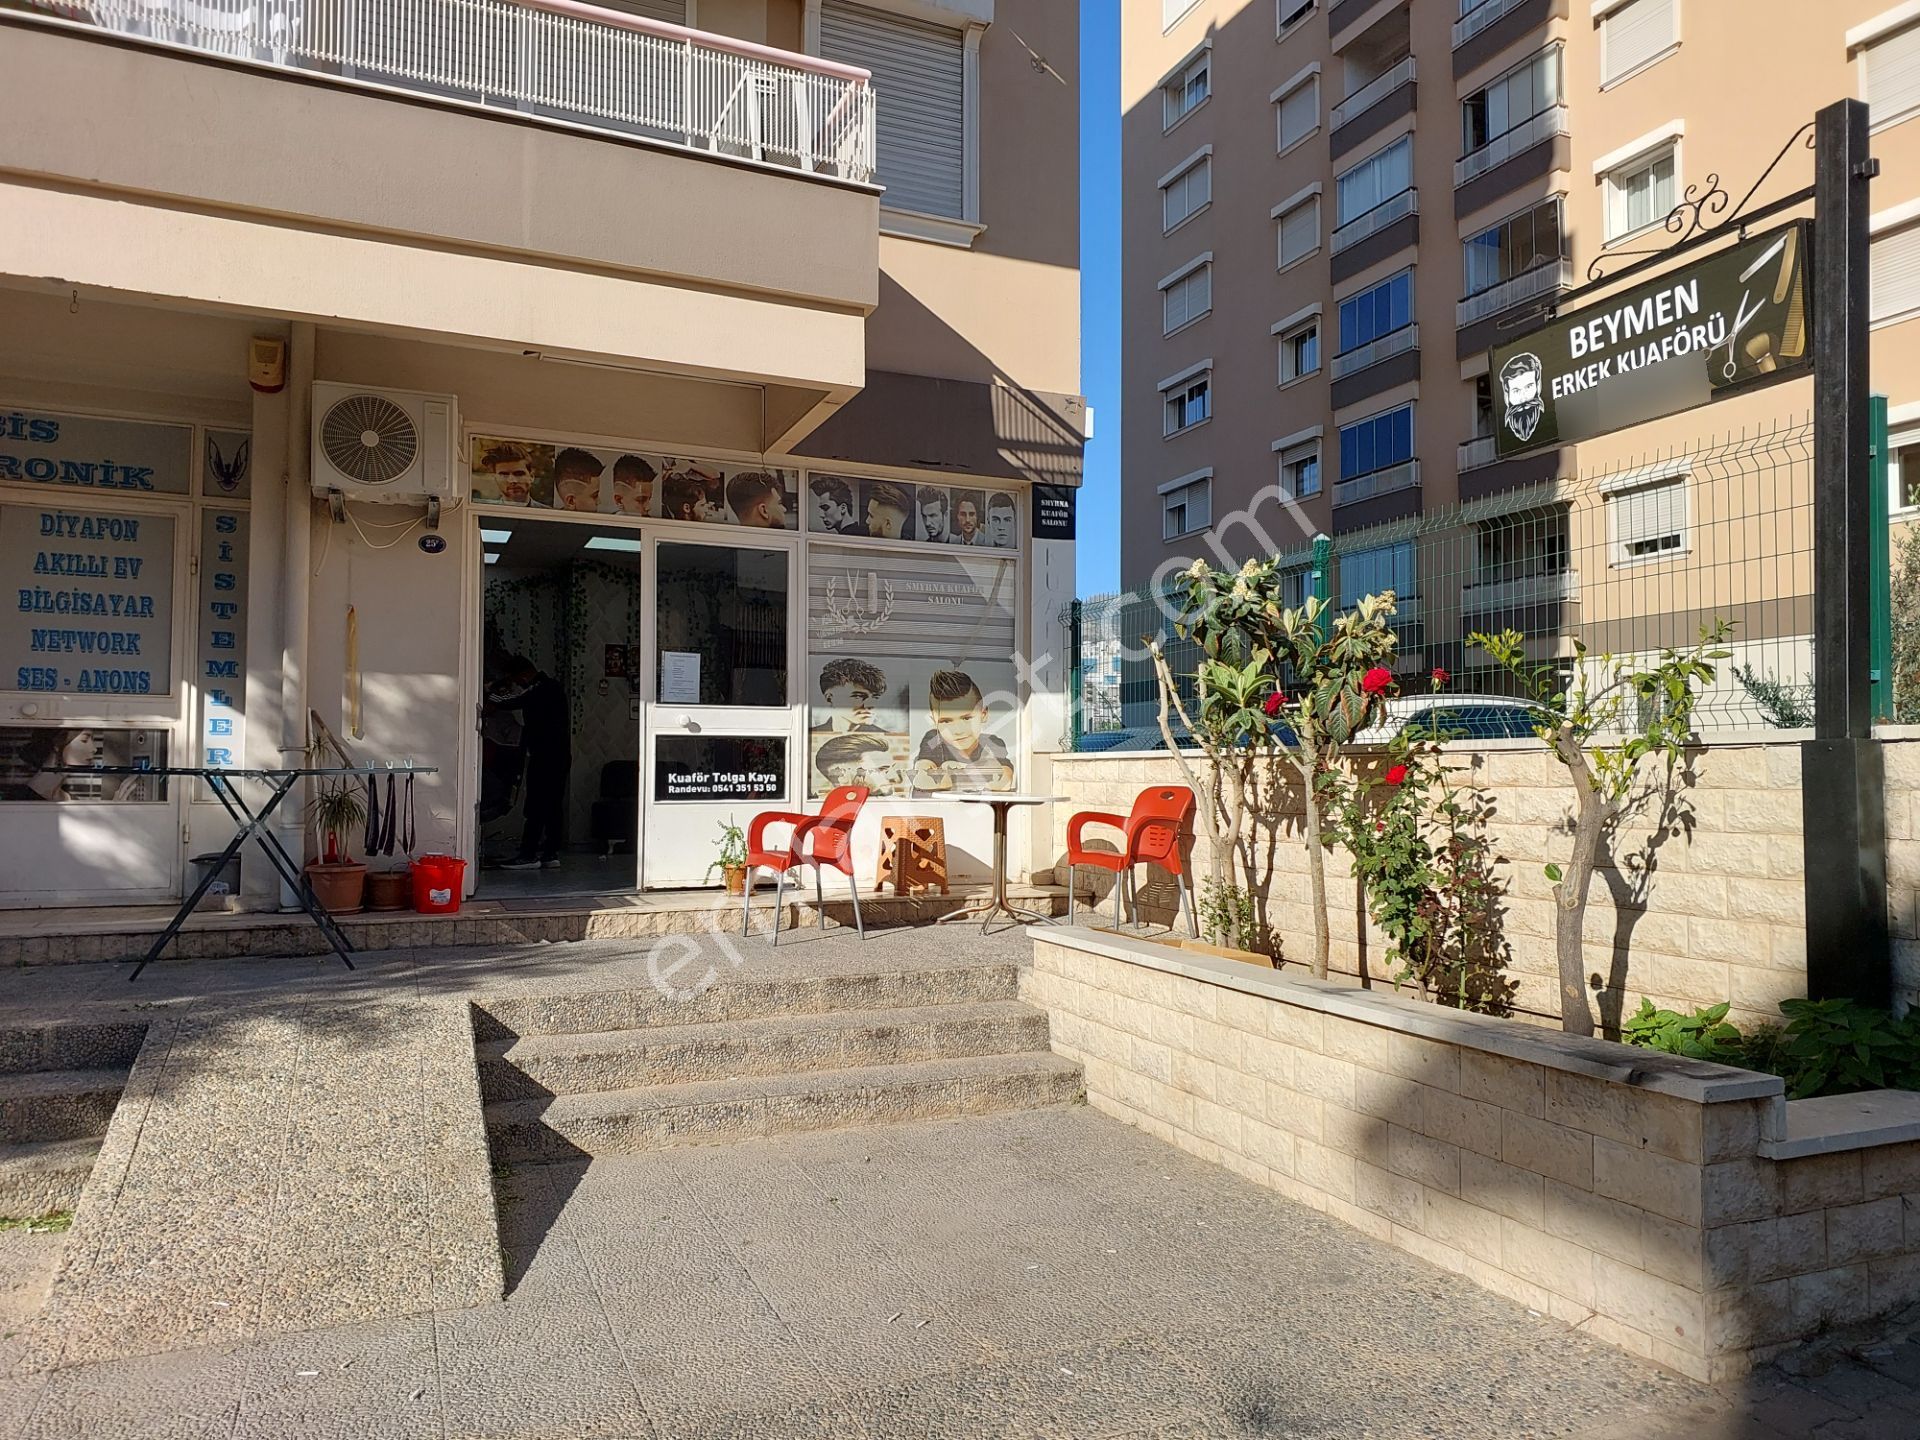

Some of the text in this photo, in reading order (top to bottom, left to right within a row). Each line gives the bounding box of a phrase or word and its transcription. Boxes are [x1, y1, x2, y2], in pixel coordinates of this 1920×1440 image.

[1569, 278, 1699, 360] BEYMEN
[1551, 311, 1726, 400] ERKEK KUAFÖRÜ
[1040, 499, 1069, 508] SMYRNA
[1041, 509, 1069, 518] KUAFÖR
[40, 510, 140, 542] DİYAFON
[1041, 518, 1068, 527] SALONU
[33, 552, 144, 579] AKILLI EV
[17, 585, 154, 618] BİLGİSAYAR
[31, 629, 141, 655] NETWORK
[17, 666, 58, 691] SES
[77, 669, 150, 693] ANONS
[668, 772, 777, 784] Kuaför Tolga Kaya
[668, 784, 777, 794] Randevu: 0541 351 53 50
